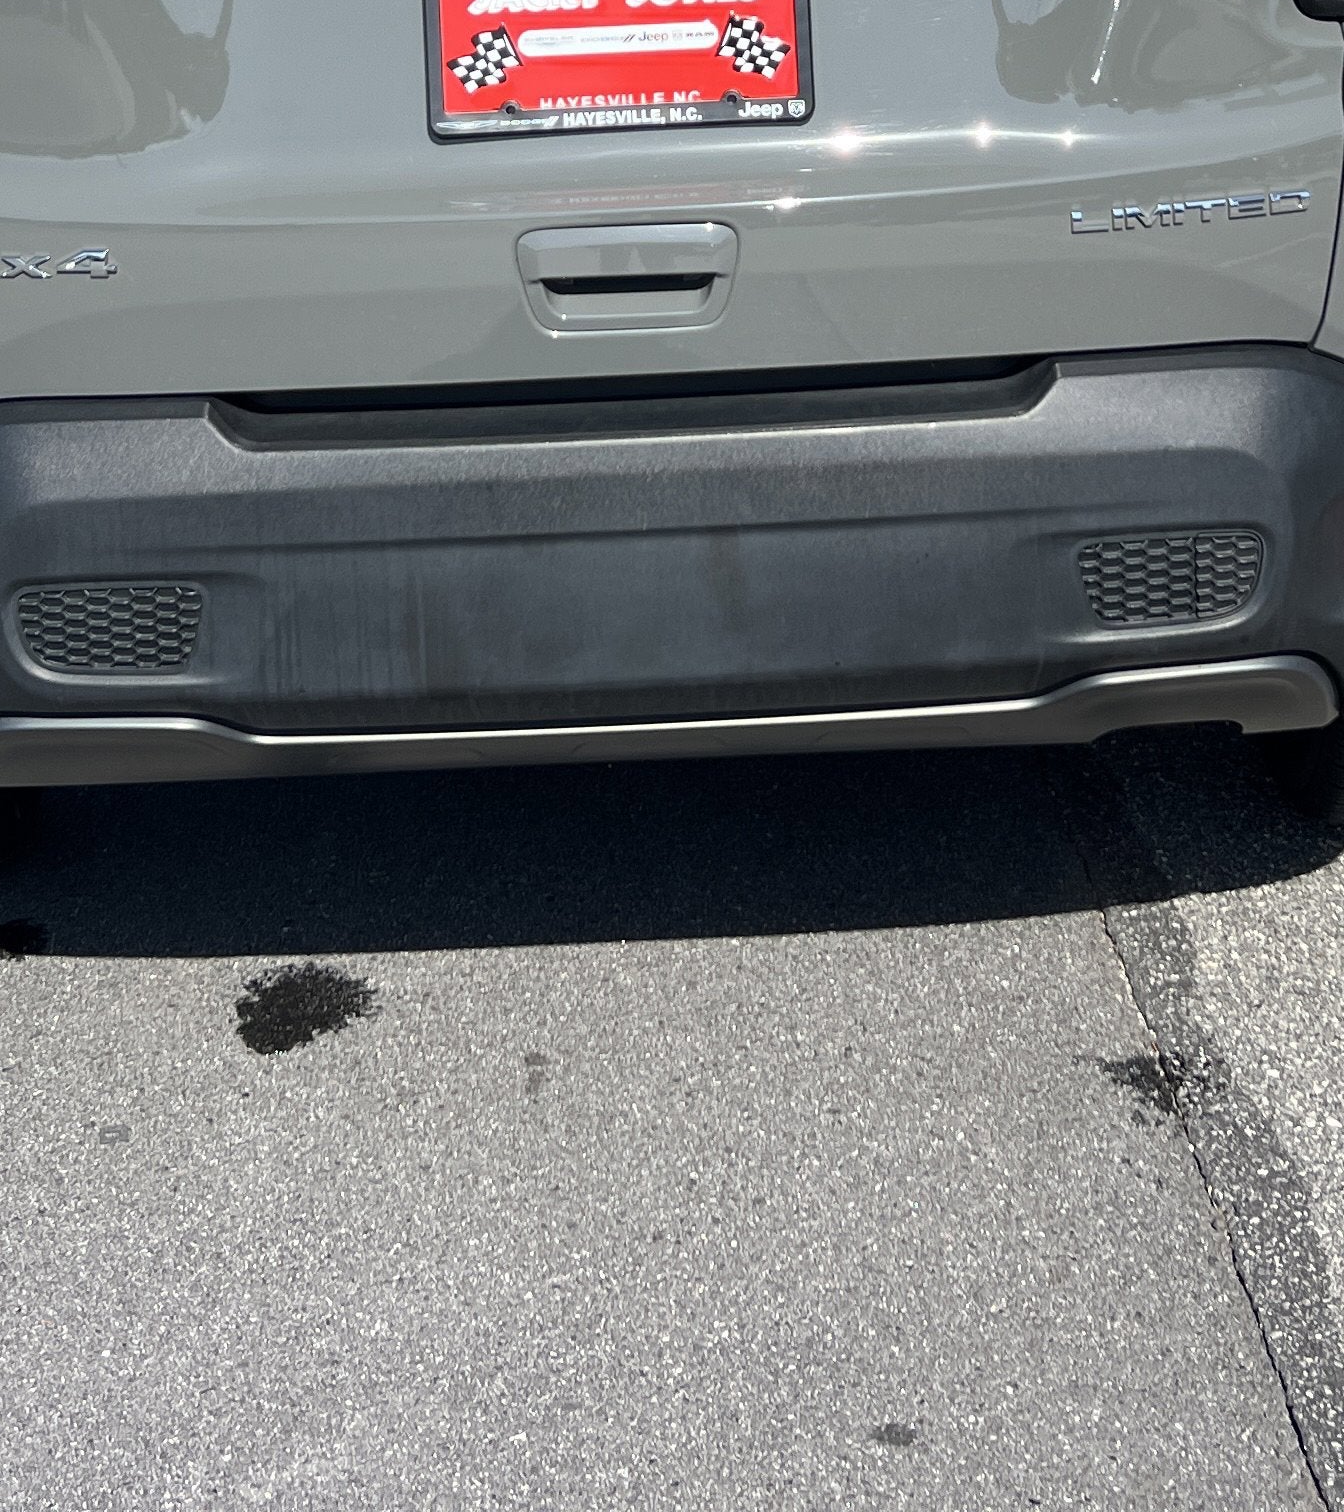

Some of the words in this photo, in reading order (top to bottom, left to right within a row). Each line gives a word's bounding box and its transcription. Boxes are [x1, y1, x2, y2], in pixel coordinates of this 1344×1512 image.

[562, 107, 667, 127] HAYESVILLE,
[669, 107, 703, 122] N.C.
[738, 101, 784, 120] Jeep
[1070, 190, 1311, 234] LIMITED
